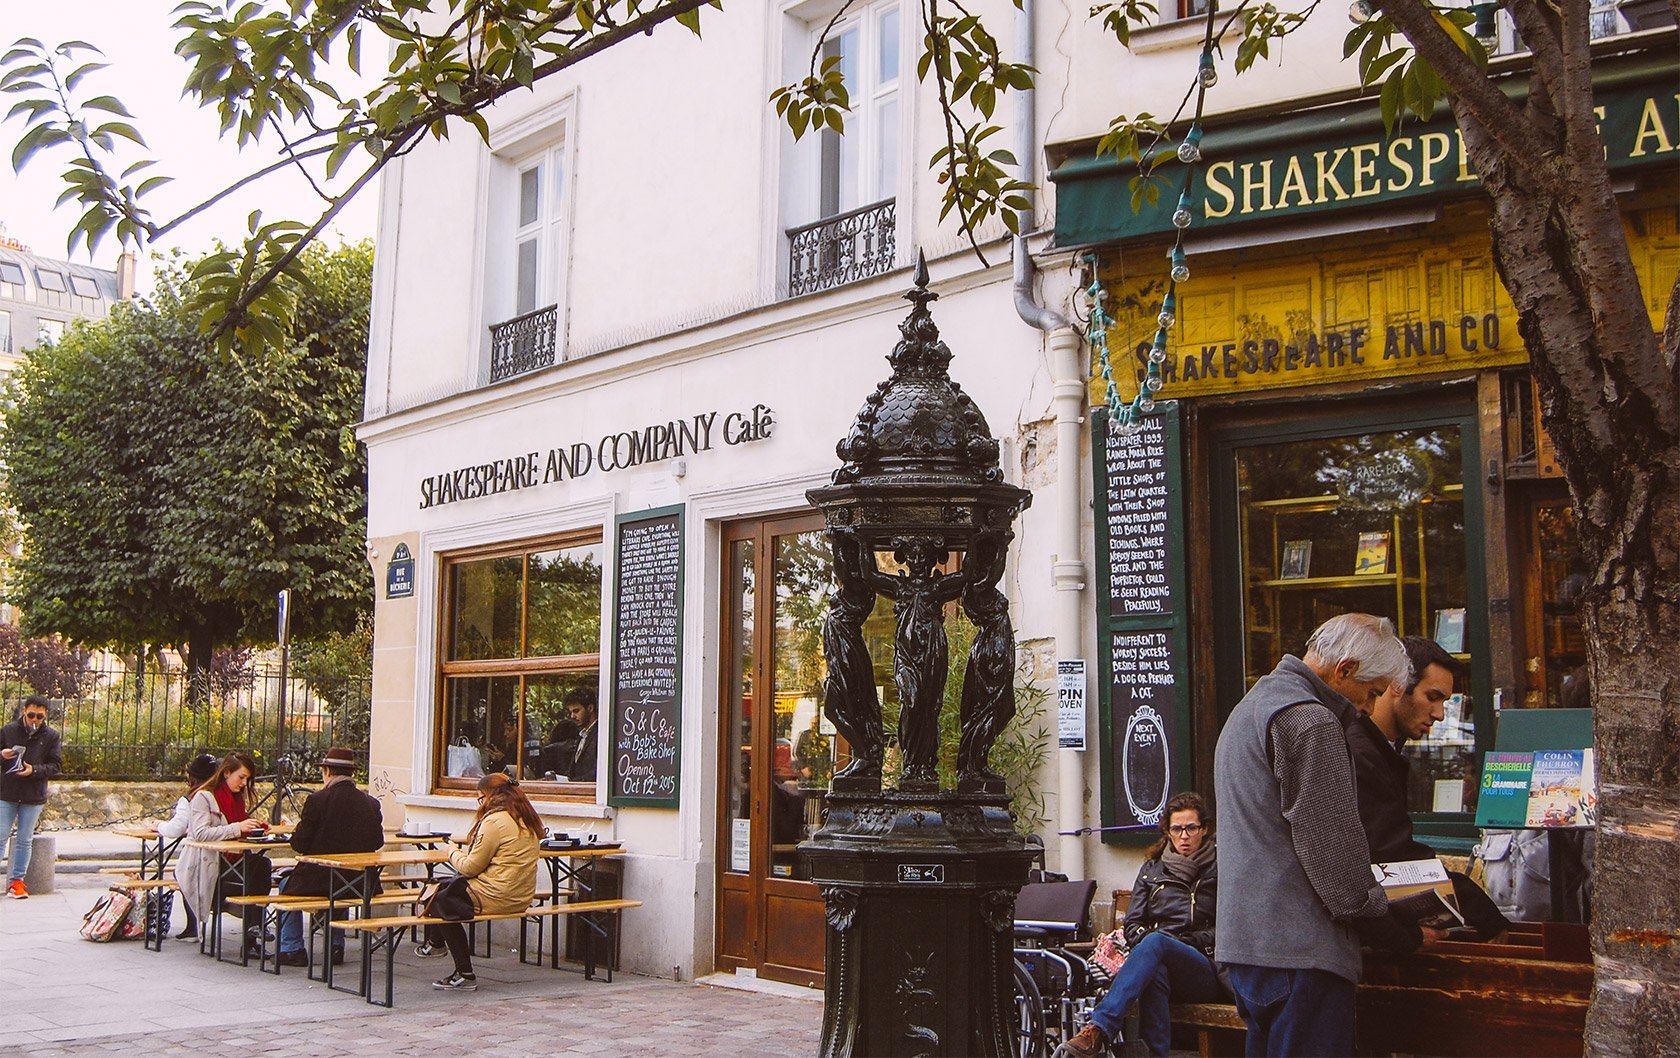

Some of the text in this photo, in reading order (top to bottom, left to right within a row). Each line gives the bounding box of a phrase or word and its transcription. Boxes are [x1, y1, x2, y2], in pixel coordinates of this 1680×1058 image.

[1629, 94, 1680, 157] A
[1382, 318, 1446, 361] AND
[1459, 313, 1499, 353] CO
[1106, 434, 1143, 448] NEWSPAPER
[419, 403, 773, 510] SHAKESPEARE AND COMPANY Café
[1127, 459, 1146, 470] ABOUT
[1148, 458, 1162, 469] THE
[1356, 465, 1381, 479] RARE
[1109, 471, 1165, 487] LITTLE SHOPS OF
[1107, 485, 1168, 500] THE LATIN QUARTER
[1108, 498, 1166, 512] WITH THEIR SHOP
[1110, 523, 1165, 536] OLD BOOKS AND
[1140, 536, 1164, 548] WHERE
[1109, 549, 1165, 562] NOBODY SEEMED TO
[1111, 561, 1164, 573] ENTER AND THE
[1146, 574, 1164, 584] COULD
[1111, 586, 1170, 598] BE SEEN READING
[1113, 633, 1166, 646] INDIFFERENT TO
[1112, 660, 1170, 672] BESIDE HIM LIES
[1113, 673, 1175, 685] A DOG OR PERHAPS
[1058, 688, 1083, 699] PIN
[1131, 687, 1138, 699] A
[622, 706, 636, 736] S
[638, 711, 647, 731] &
[1135, 724, 1154, 733] NEXT
[632, 733, 656, 751] Bob's
[1134, 733, 1157, 742] EVENT
[637, 743, 676, 765] Bake Shop
[1543, 752, 1573, 760] COLIN
[617, 753, 654, 778] Opening
[623, 777, 640, 794] Oct
[658, 775, 675, 795] 2015
[1483, 773, 1492, 788] 3
